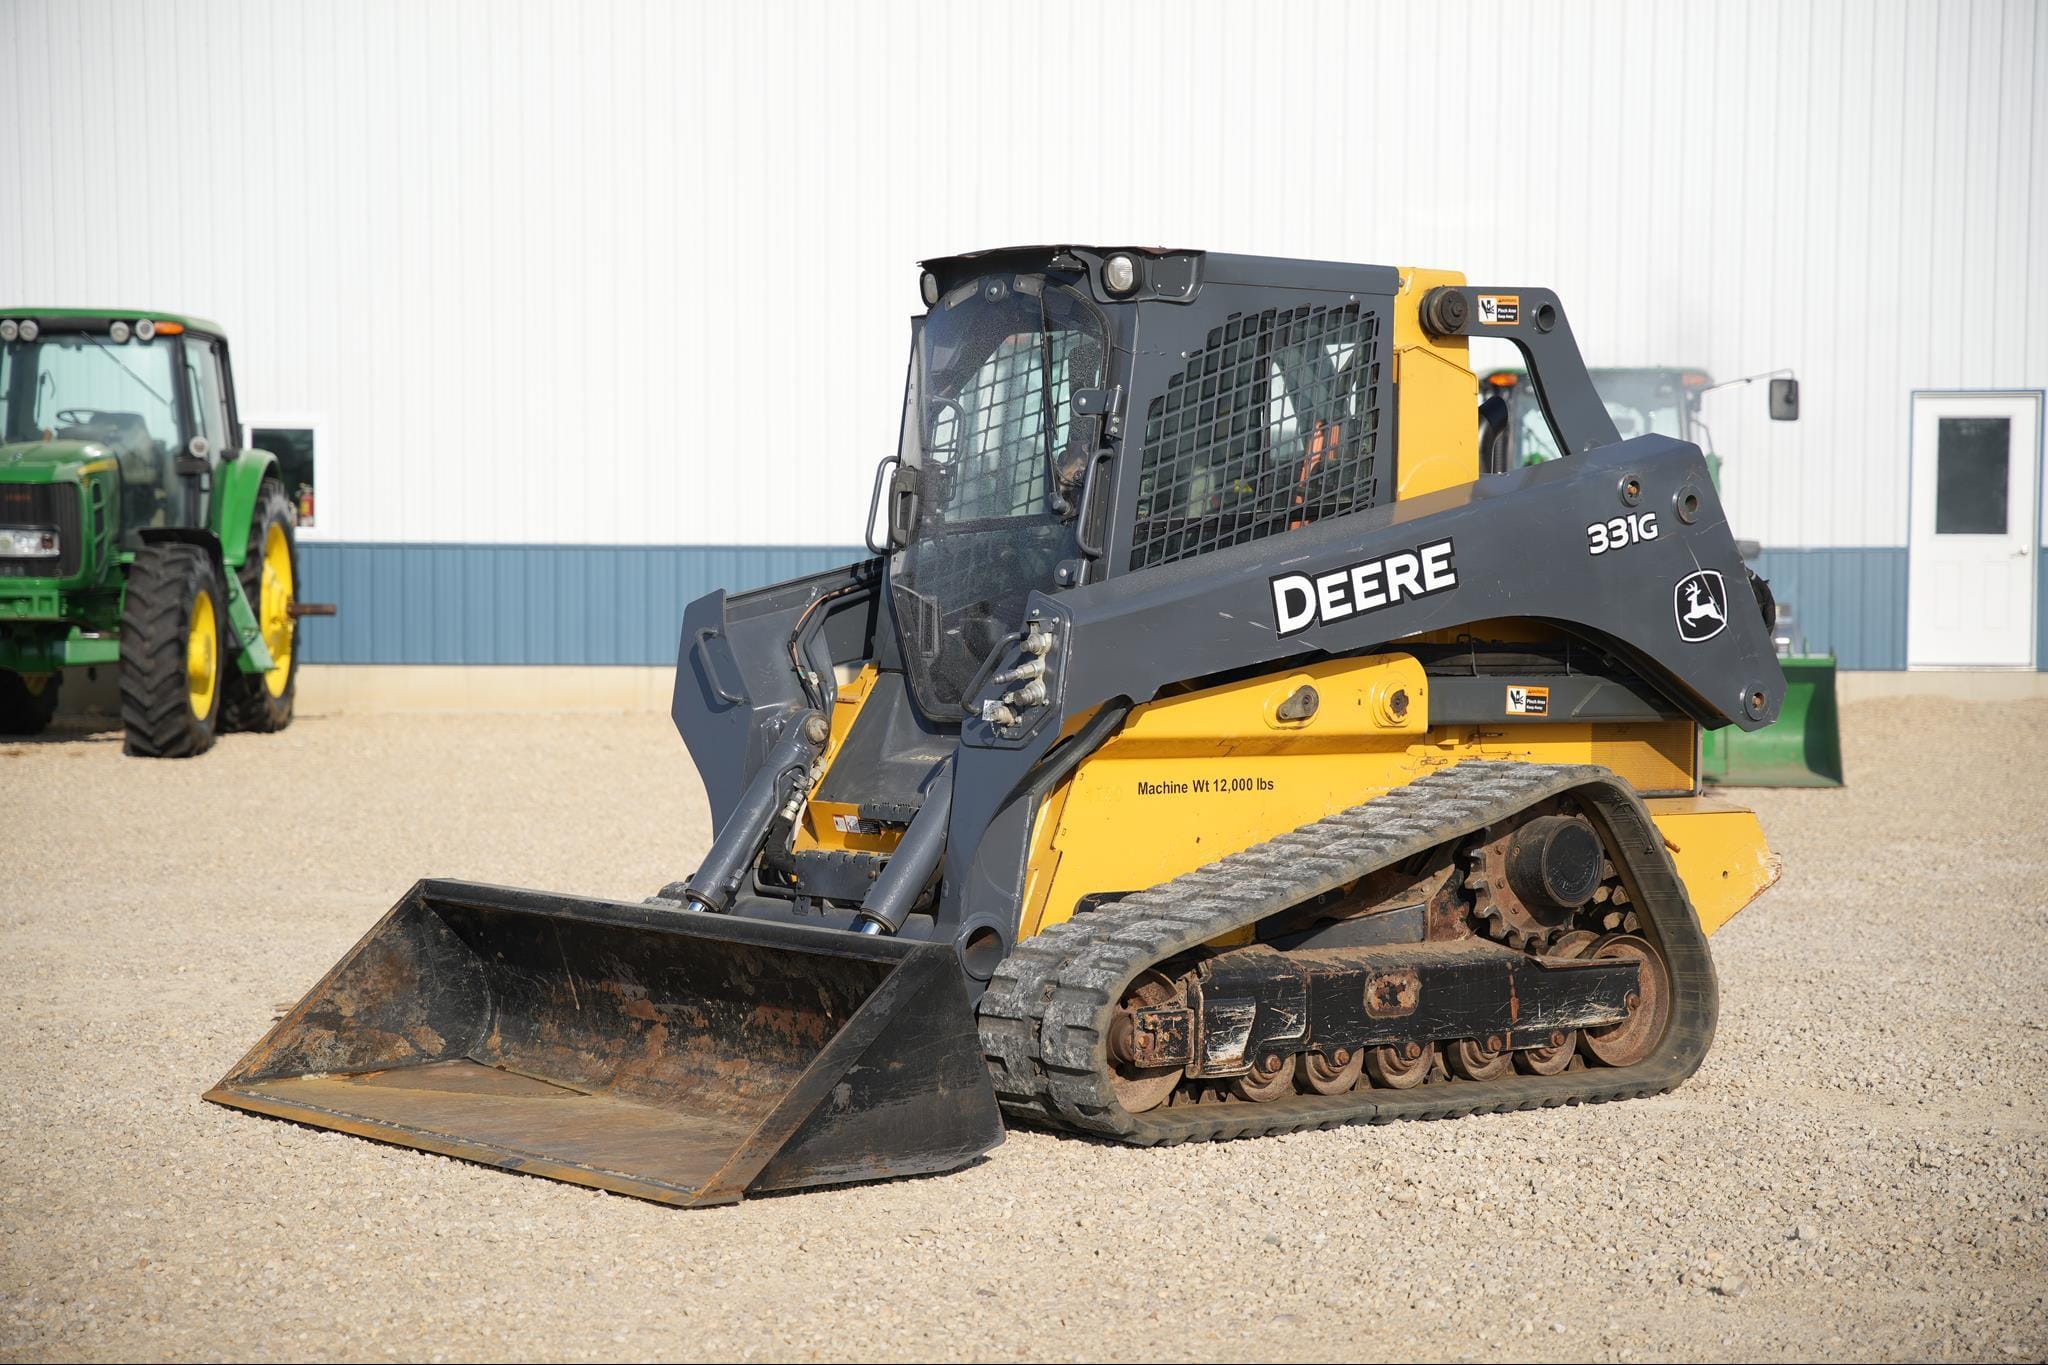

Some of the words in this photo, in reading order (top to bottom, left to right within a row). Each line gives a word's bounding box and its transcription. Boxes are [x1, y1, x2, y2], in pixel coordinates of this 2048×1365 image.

[1587, 512, 1658, 555] 331G
[1273, 541, 1456, 635] DEERE
[1137, 780, 1189, 795] Machine
[1192, 779, 1210, 793] Wt
[1212, 778, 1253, 794] 12,000
[1256, 777, 1274, 791] lbs
